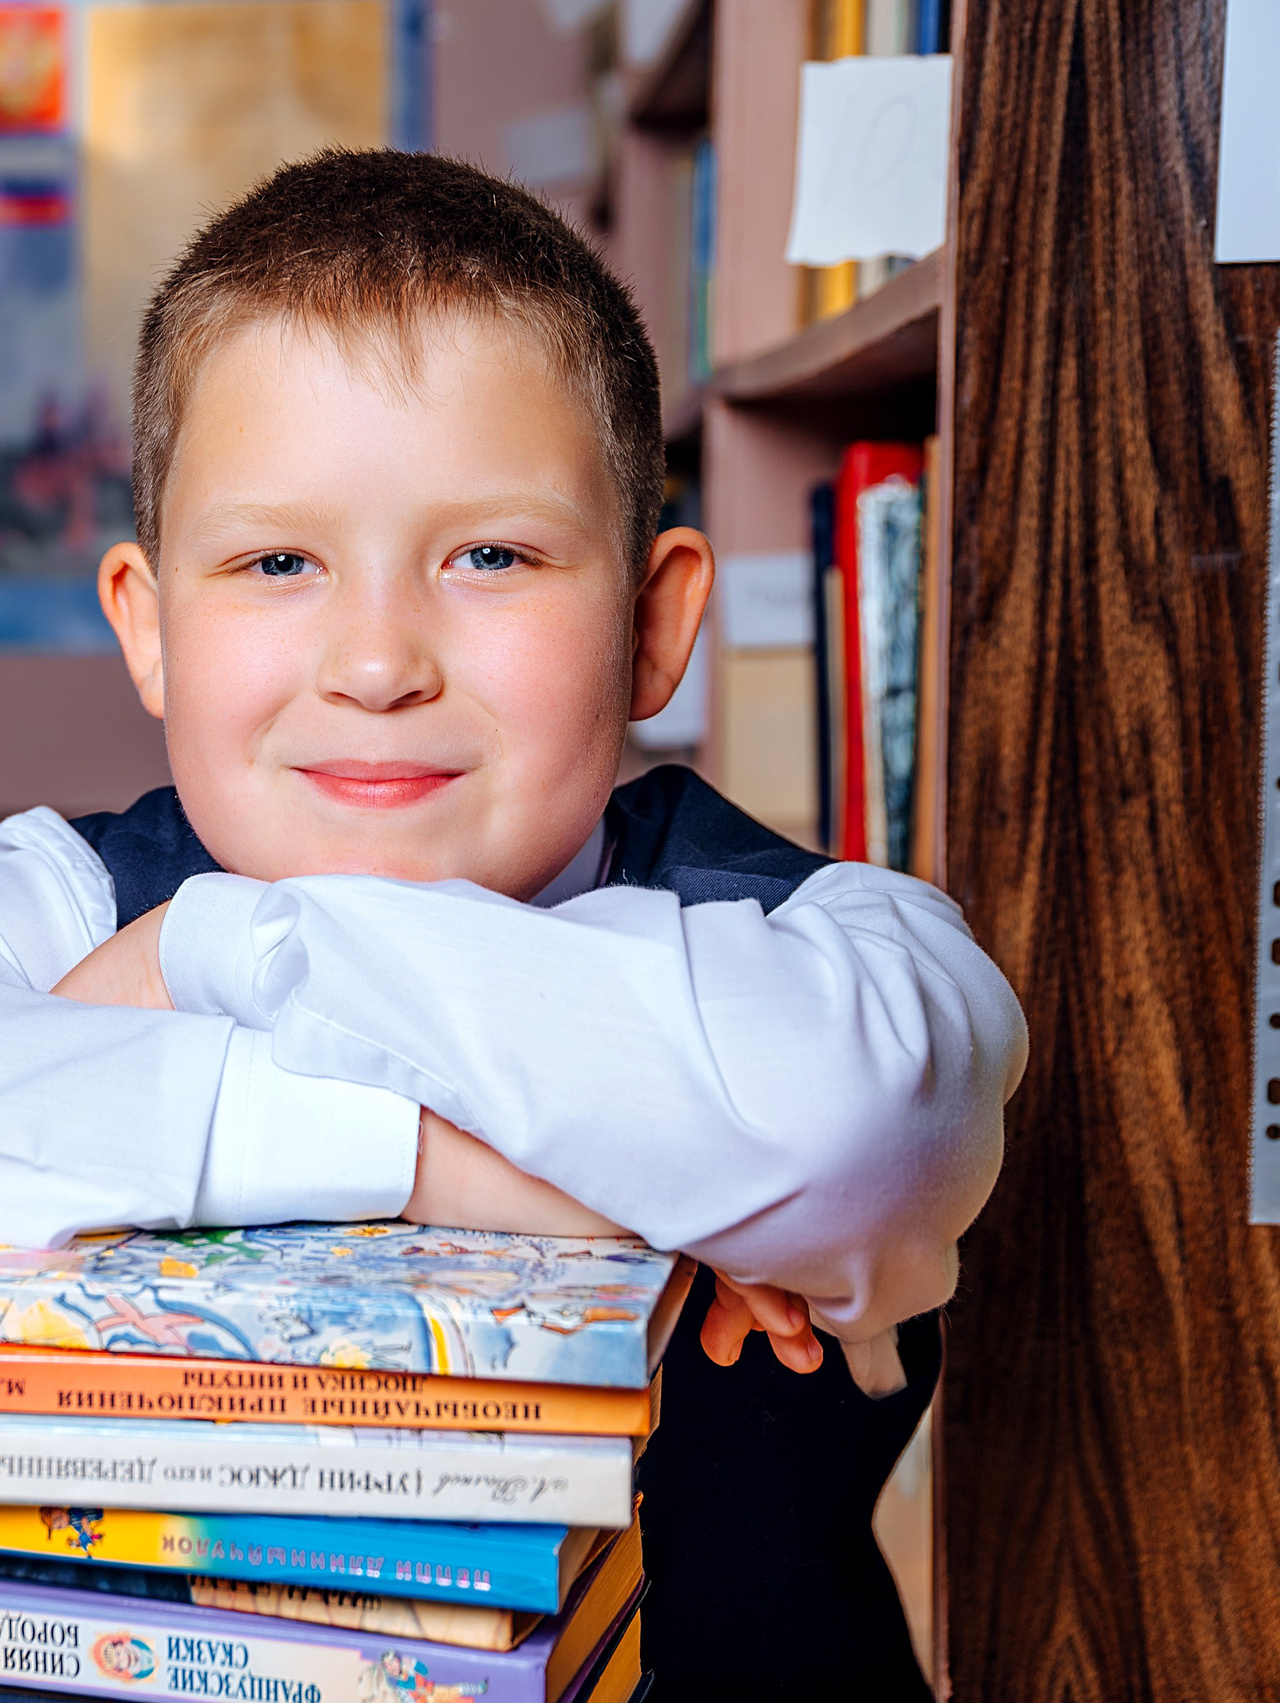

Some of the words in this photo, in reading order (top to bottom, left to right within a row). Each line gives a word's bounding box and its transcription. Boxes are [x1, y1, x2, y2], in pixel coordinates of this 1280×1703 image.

[182, 1370, 284, 1390] ИНТУТЫ
[292, 1374, 310, 1390] И
[316, 1373, 428, 1395] ЛЮСИКА
[57, 1390, 287, 1415] ПРИКЛЮЧЕНИЯ
[304, 1398, 542, 1422] НЕОБЫЧАЙНЫЕ
[219, 1464, 310, 1490] ДЖЮС
[318, 1469, 411, 1496] УРФИН
[395, 1560, 491, 1592] ПЕППИ
[2, 1646, 81, 1678] СИНЯЯ
[166, 1636, 248, 1670] СКАЗКИ
[166, 1666, 320, 1703] ФРАНЦУЗСКИЕ
